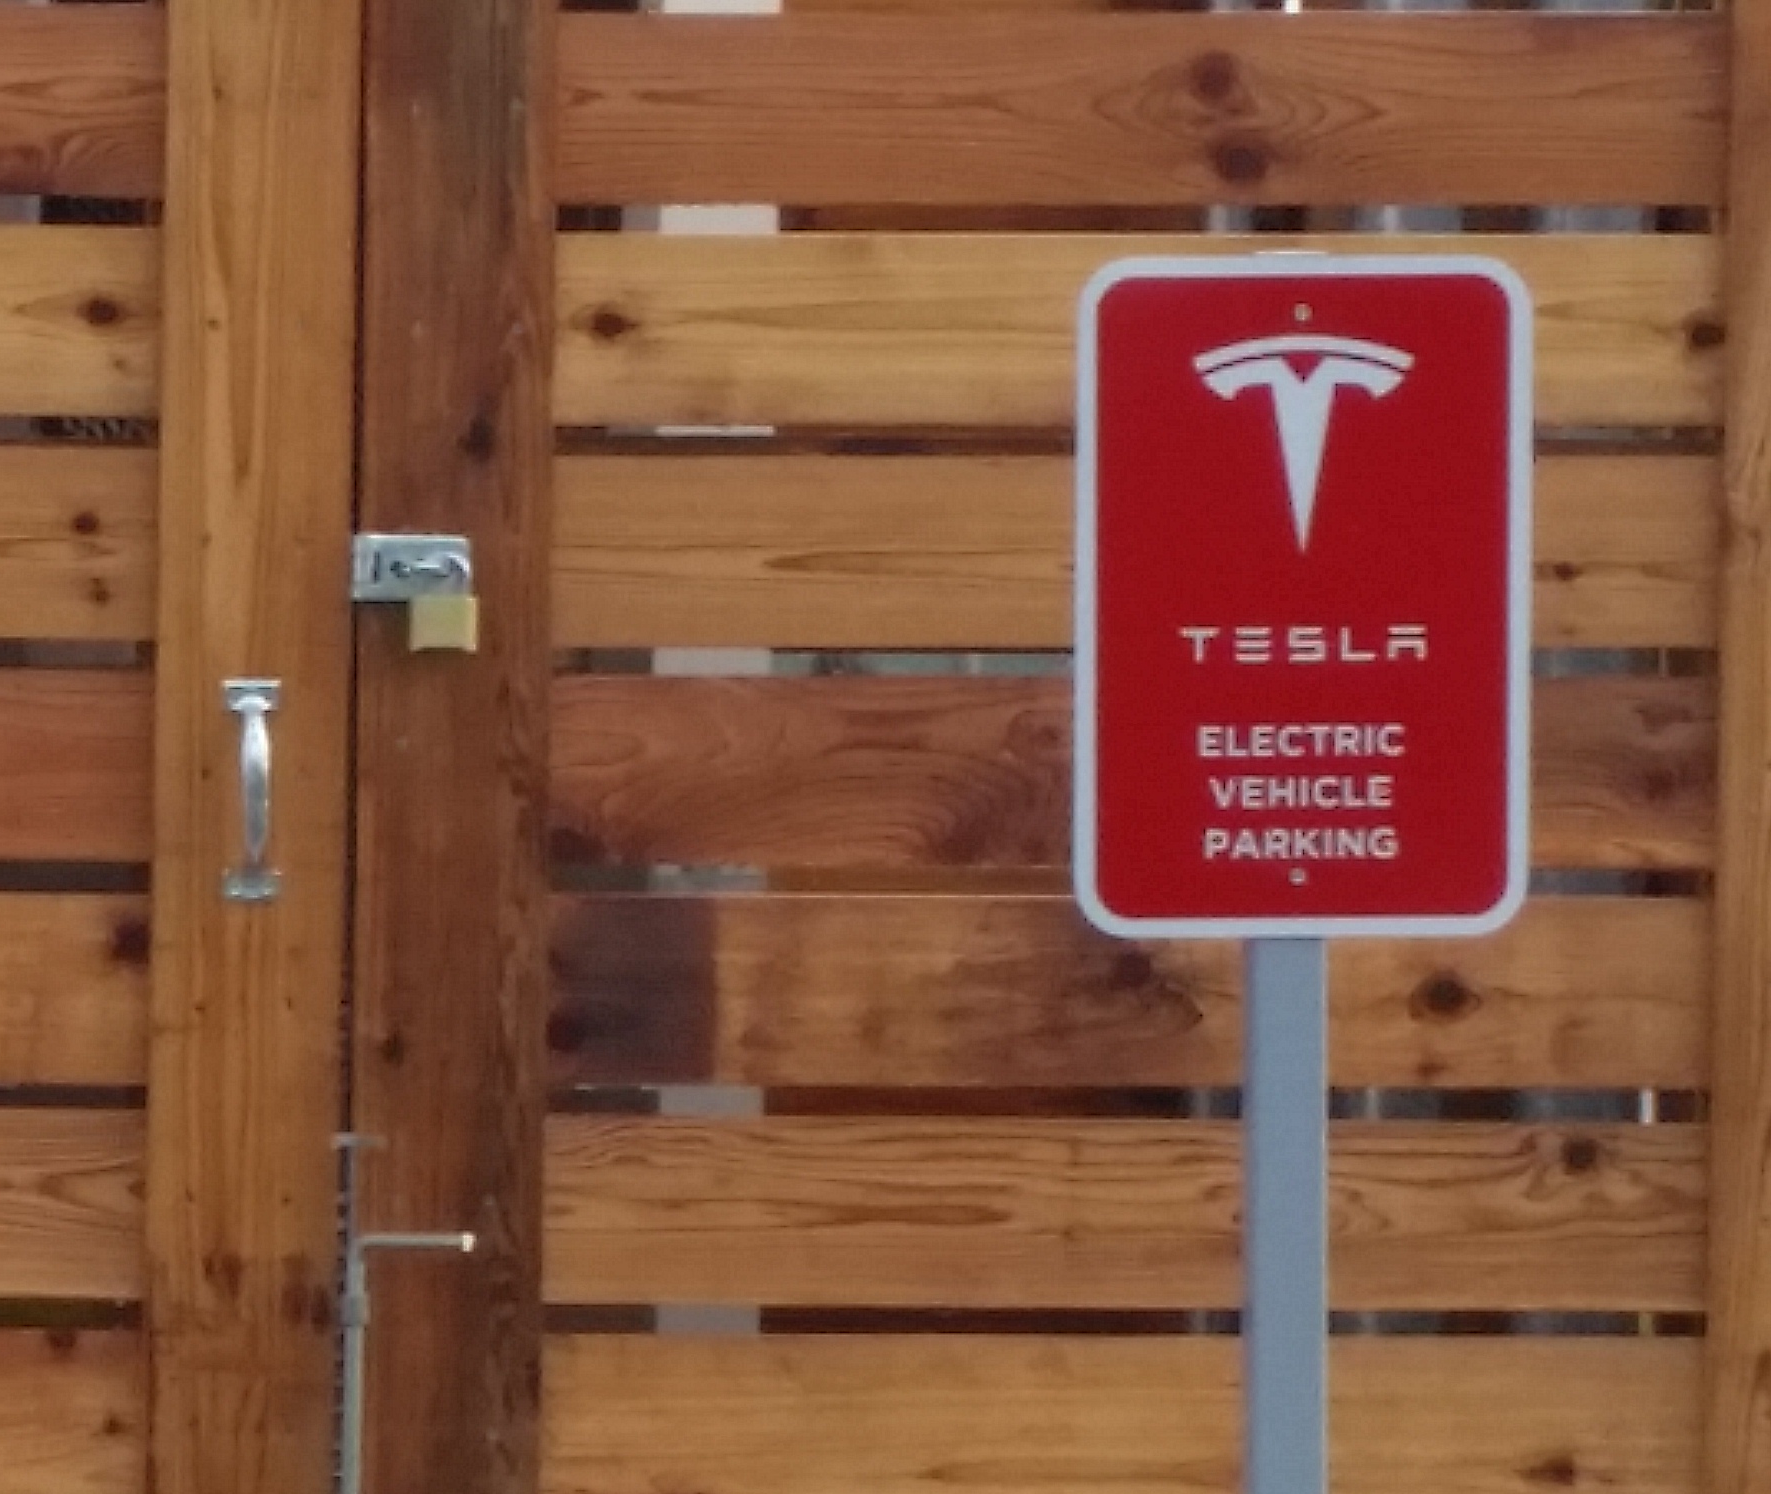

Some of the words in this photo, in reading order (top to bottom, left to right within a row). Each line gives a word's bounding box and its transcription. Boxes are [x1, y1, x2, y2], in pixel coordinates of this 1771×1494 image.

[1178, 624, 1428, 663] TESLA
[1197, 723, 1406, 758] ELECTRIC
[1208, 774, 1394, 810] VEHICLE
[1203, 826, 1399, 860] PARKING
